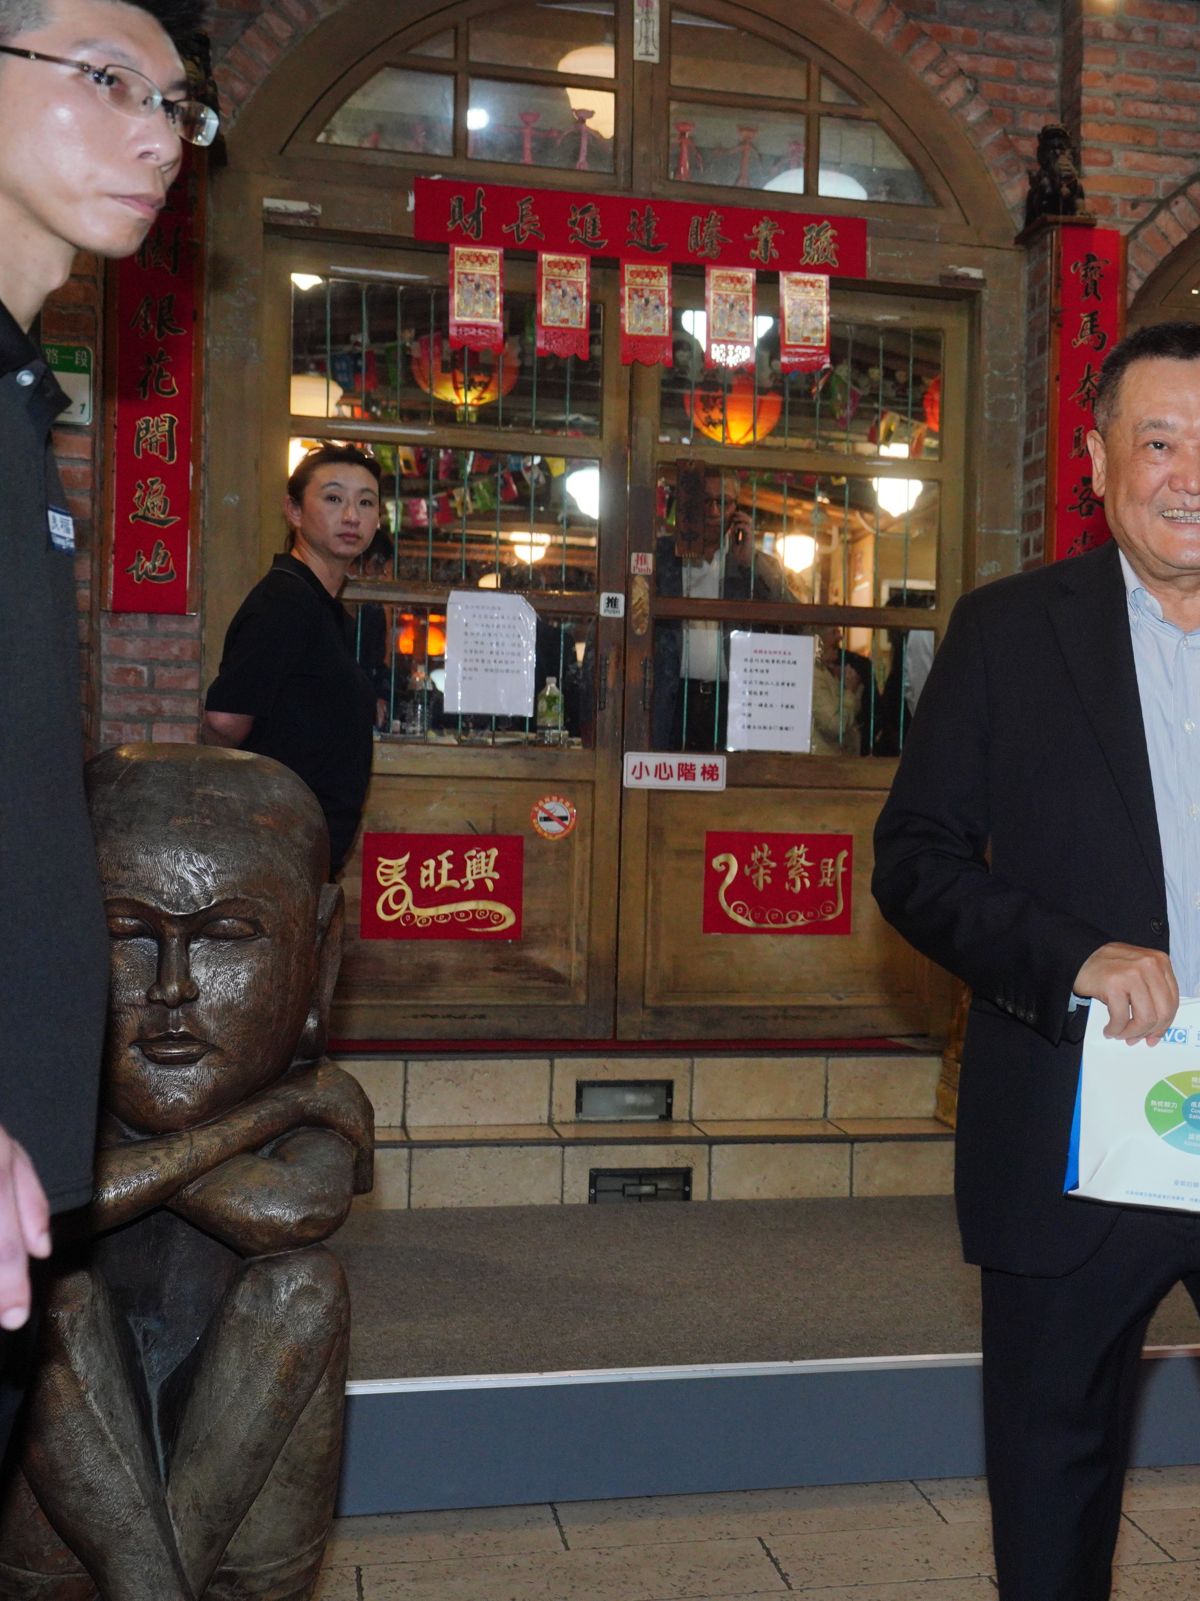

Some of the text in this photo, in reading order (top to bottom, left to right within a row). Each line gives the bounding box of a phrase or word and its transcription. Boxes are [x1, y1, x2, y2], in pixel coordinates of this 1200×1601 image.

[606, 596, 619, 609] 推
[631, 761, 720, 782] 小心階梯
[1161, 1027, 1187, 1043] VC
